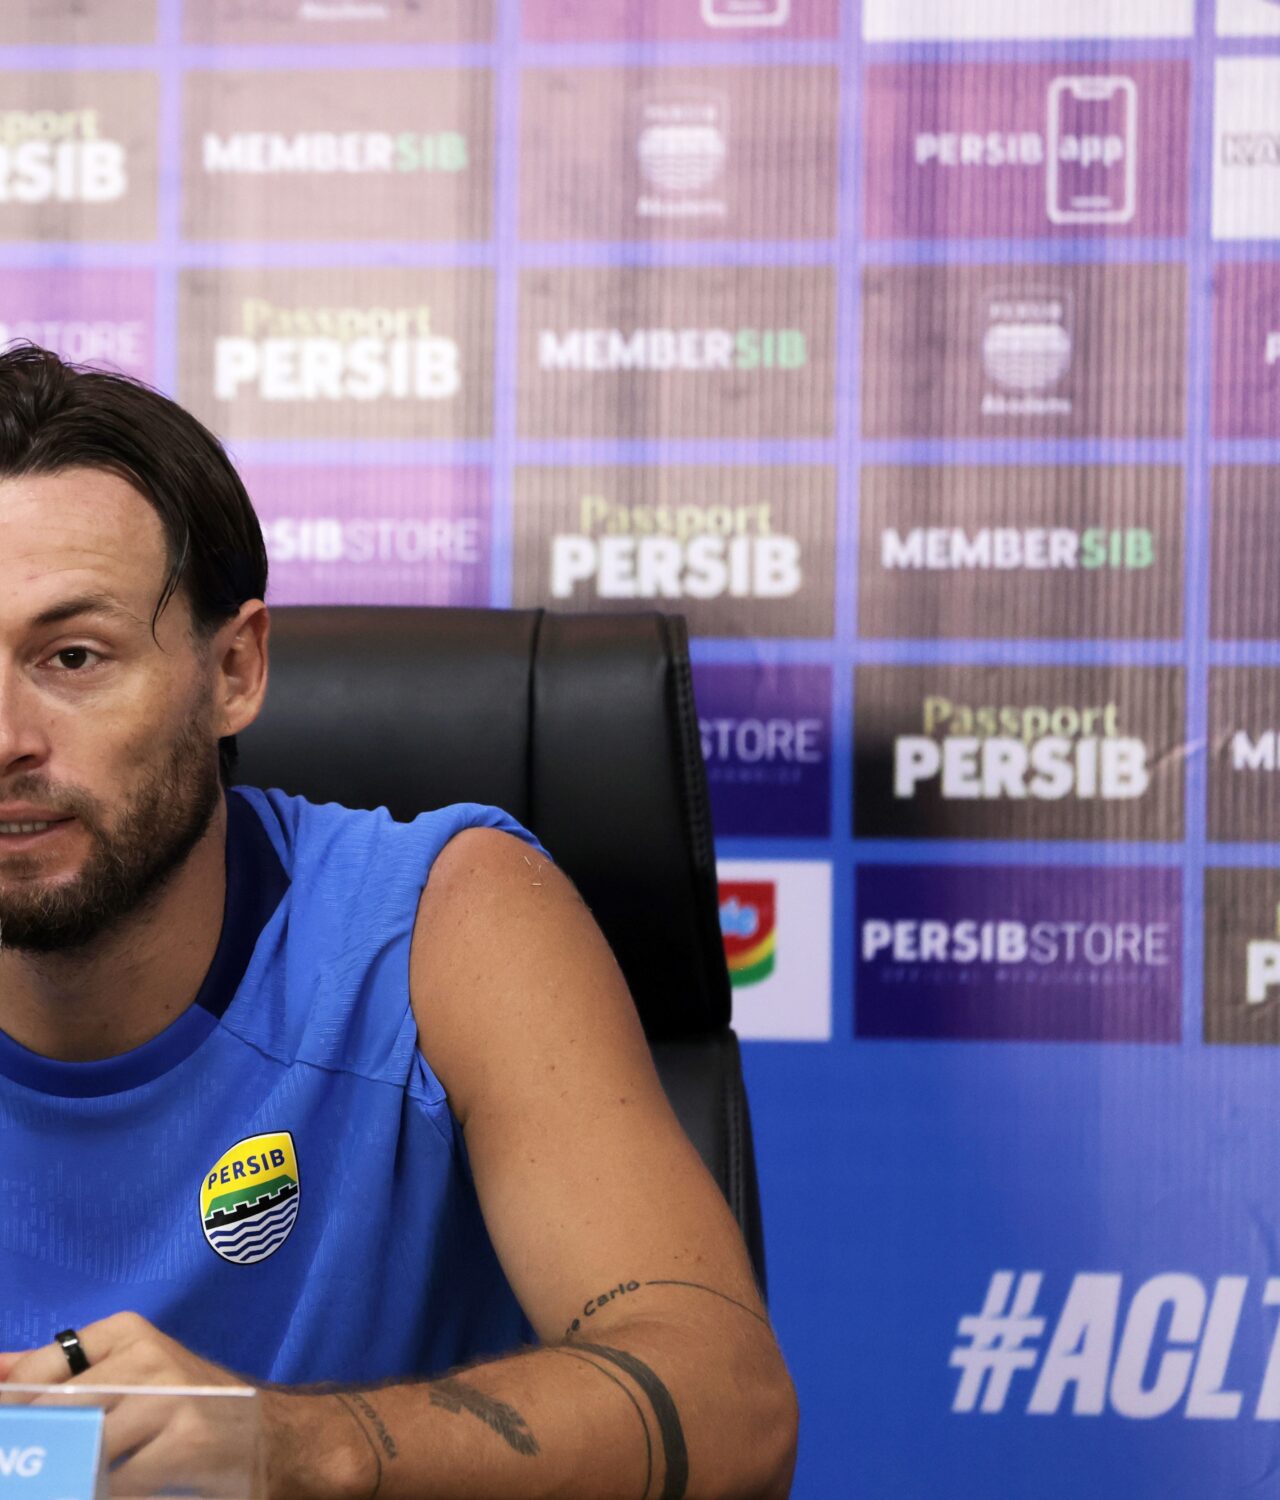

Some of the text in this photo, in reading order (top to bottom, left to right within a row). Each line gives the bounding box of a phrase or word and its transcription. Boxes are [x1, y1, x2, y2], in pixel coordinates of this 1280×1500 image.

[203, 131, 468, 173] MEMBERSIB
[915, 132, 1124, 168] PERSIB app
[242, 300, 431, 340] Passport
[214, 336, 460, 400] PERSIB
[539, 330, 806, 369] MEMBERSIB
[580, 496, 771, 540] Passport
[264, 518, 479, 563] SIBSTORE
[881, 528, 1154, 569] MEMBERSIB
[551, 534, 801, 597] PERSIB
[923, 697, 1118, 742] Passport
[894, 736, 1150, 800] PERSIB
[862, 921, 1170, 966] PERSIBSTORE
[208, 1149, 285, 1190] PERSIB
[583, 1280, 640, 1317] Carlo
